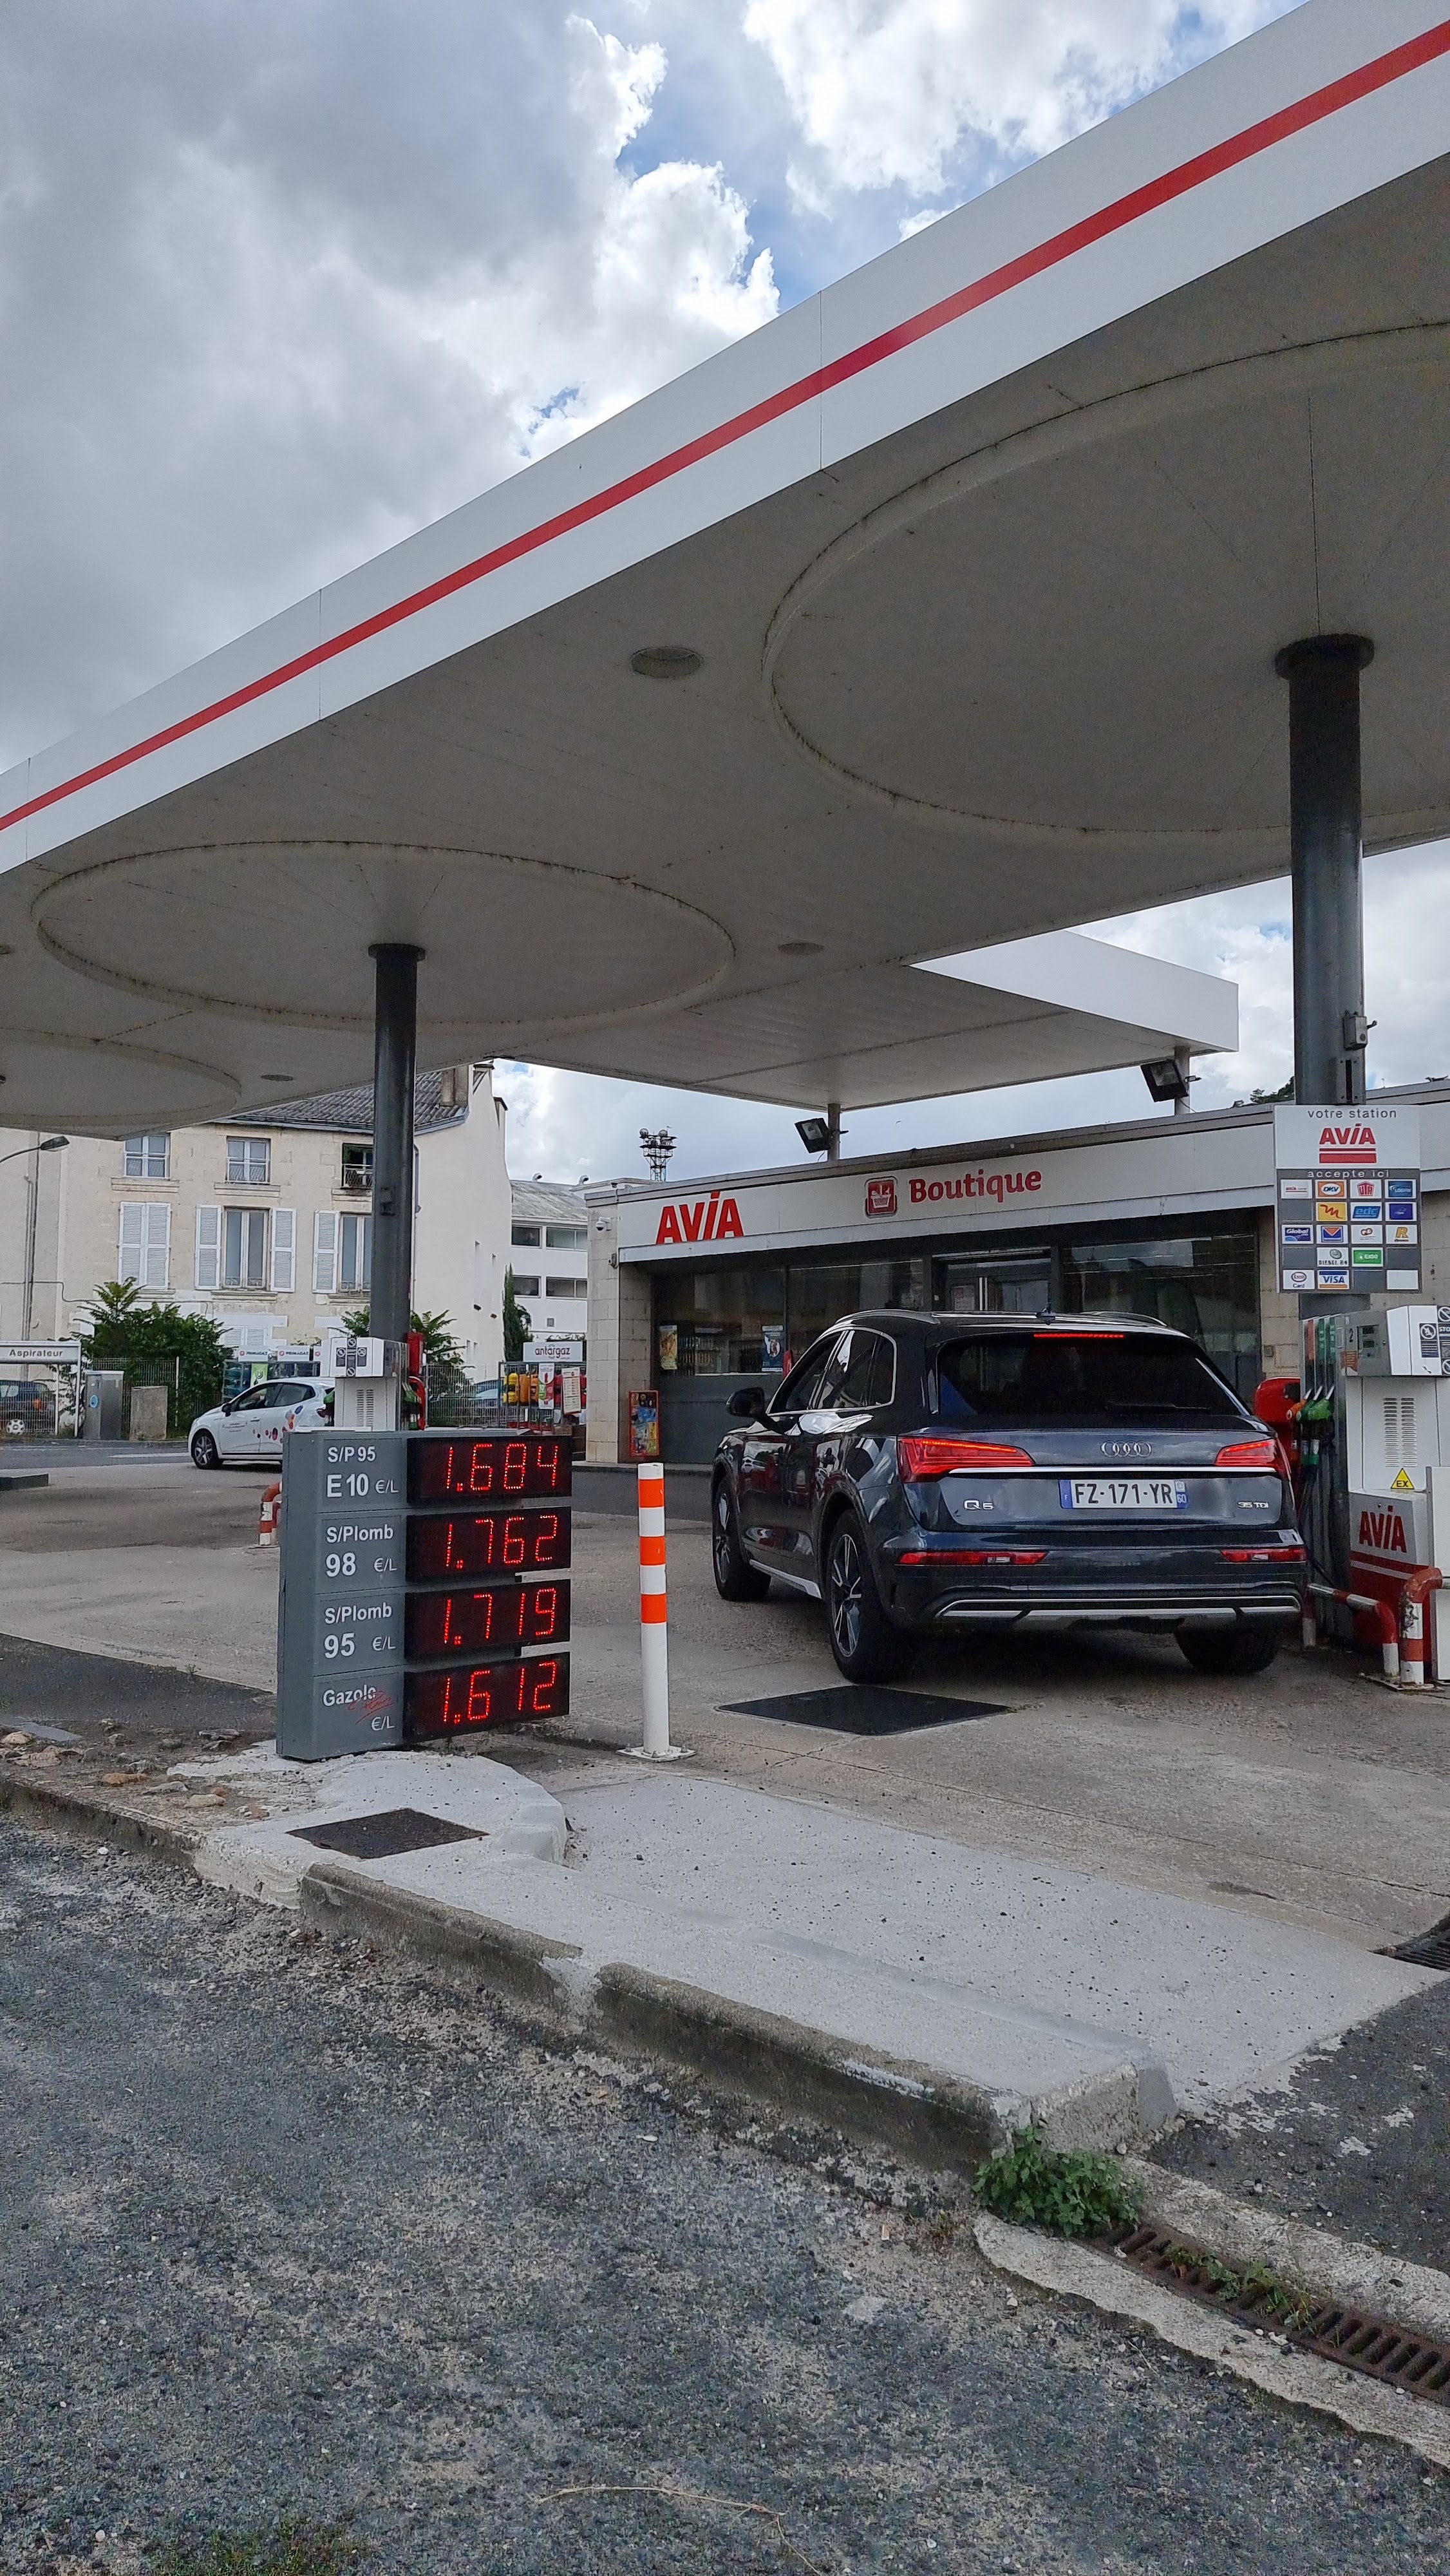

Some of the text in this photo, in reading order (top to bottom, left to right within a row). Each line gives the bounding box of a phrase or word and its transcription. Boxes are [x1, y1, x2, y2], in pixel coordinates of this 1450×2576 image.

[1308, 1108, 1397, 1118] votre station
[1319, 1122, 1376, 1144] AVIA
[1308, 1169, 1389, 1178] accepte ici
[909, 1169, 1042, 1203] Boutique
[655, 1191, 744, 1244] AVIA
[1349, 1328, 1353, 1343] 2
[9, 1349, 63, 1358] Aspirateur
[535, 1346, 570, 1359] antargaz
[446, 1443, 559, 1492] 1.684
[375, 1479, 399, 1494] €/L
[1075, 1483, 1173, 1504] FZ-171-YR
[325, 1524, 394, 1544] S/Plomb
[1359, 1506, 1407, 1553] AVIA
[446, 1514, 558, 1569] 1.762
[325, 1552, 397, 1577] 98 €/L
[325, 1602, 392, 1624] S/Plomb
[444, 1587, 557, 1646] 1.719
[324, 1633, 396, 1659] 95 €/L
[444, 1662, 558, 1725] 1.612
[370, 1716, 395, 1731] €/L
